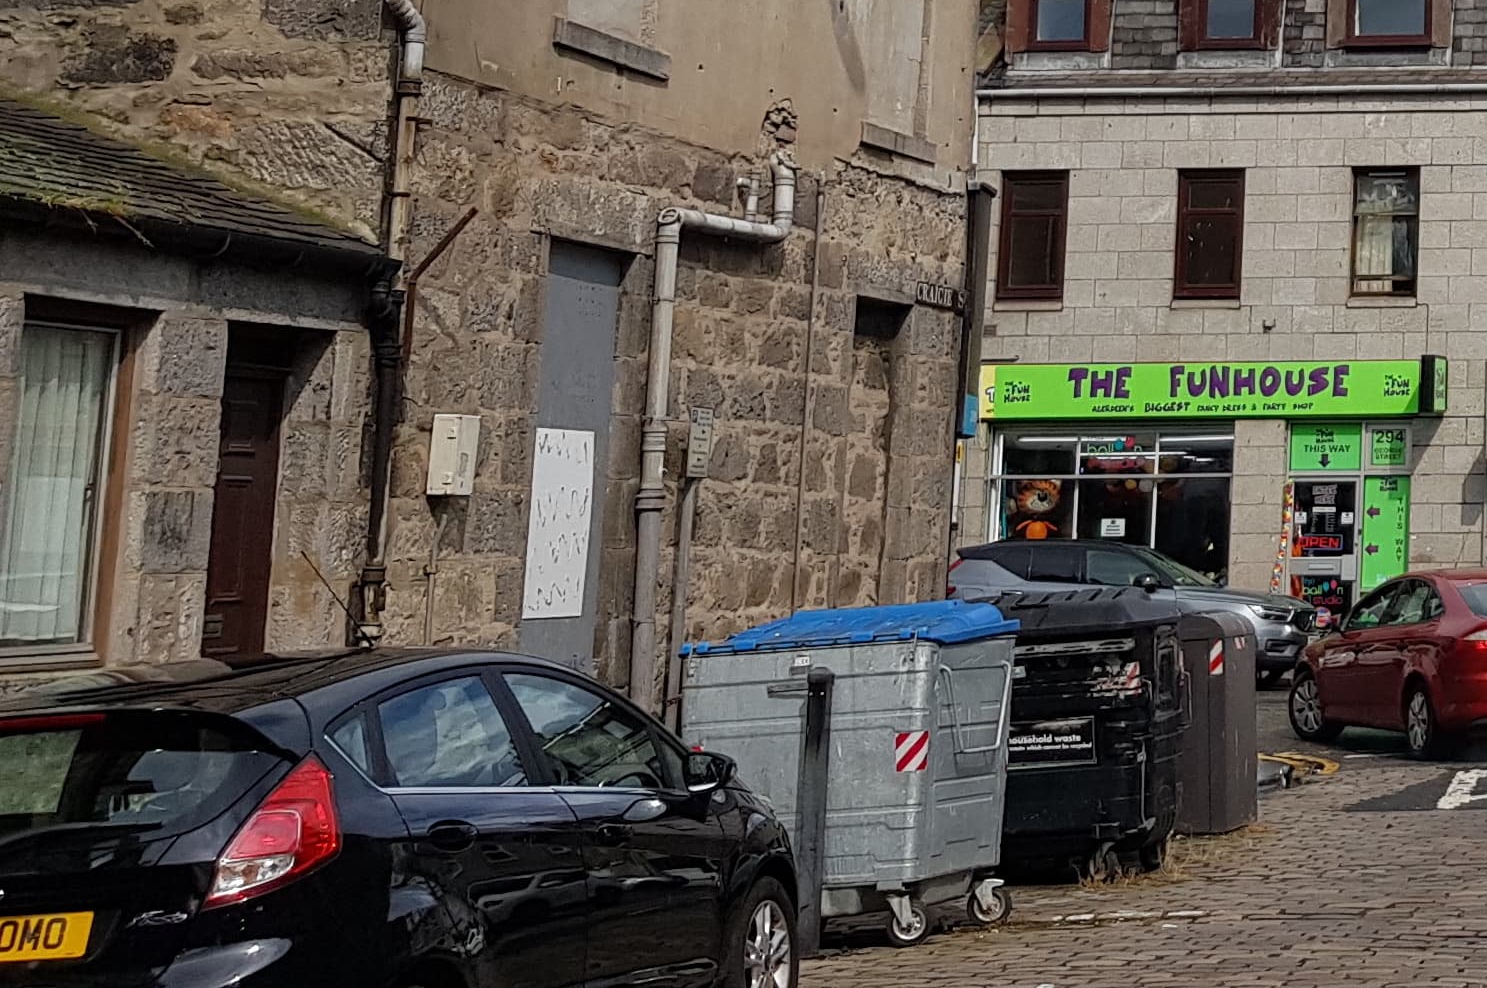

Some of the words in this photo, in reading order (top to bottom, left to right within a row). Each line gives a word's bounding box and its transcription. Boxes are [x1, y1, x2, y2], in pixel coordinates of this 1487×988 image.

[1068, 367, 1132, 399] THE
[1169, 365, 1349, 399] FUNHOUSE
[1144, 401, 1191, 412] BIGGEST
[1263, 403, 1287, 411] PARTY
[1292, 402, 1314, 410] SHOP
[1376, 431, 1404, 443] 294
[1304, 444, 1326, 452] THIS
[1329, 444, 1351, 452] WAY
[1054, 735, 1081, 743] waste
